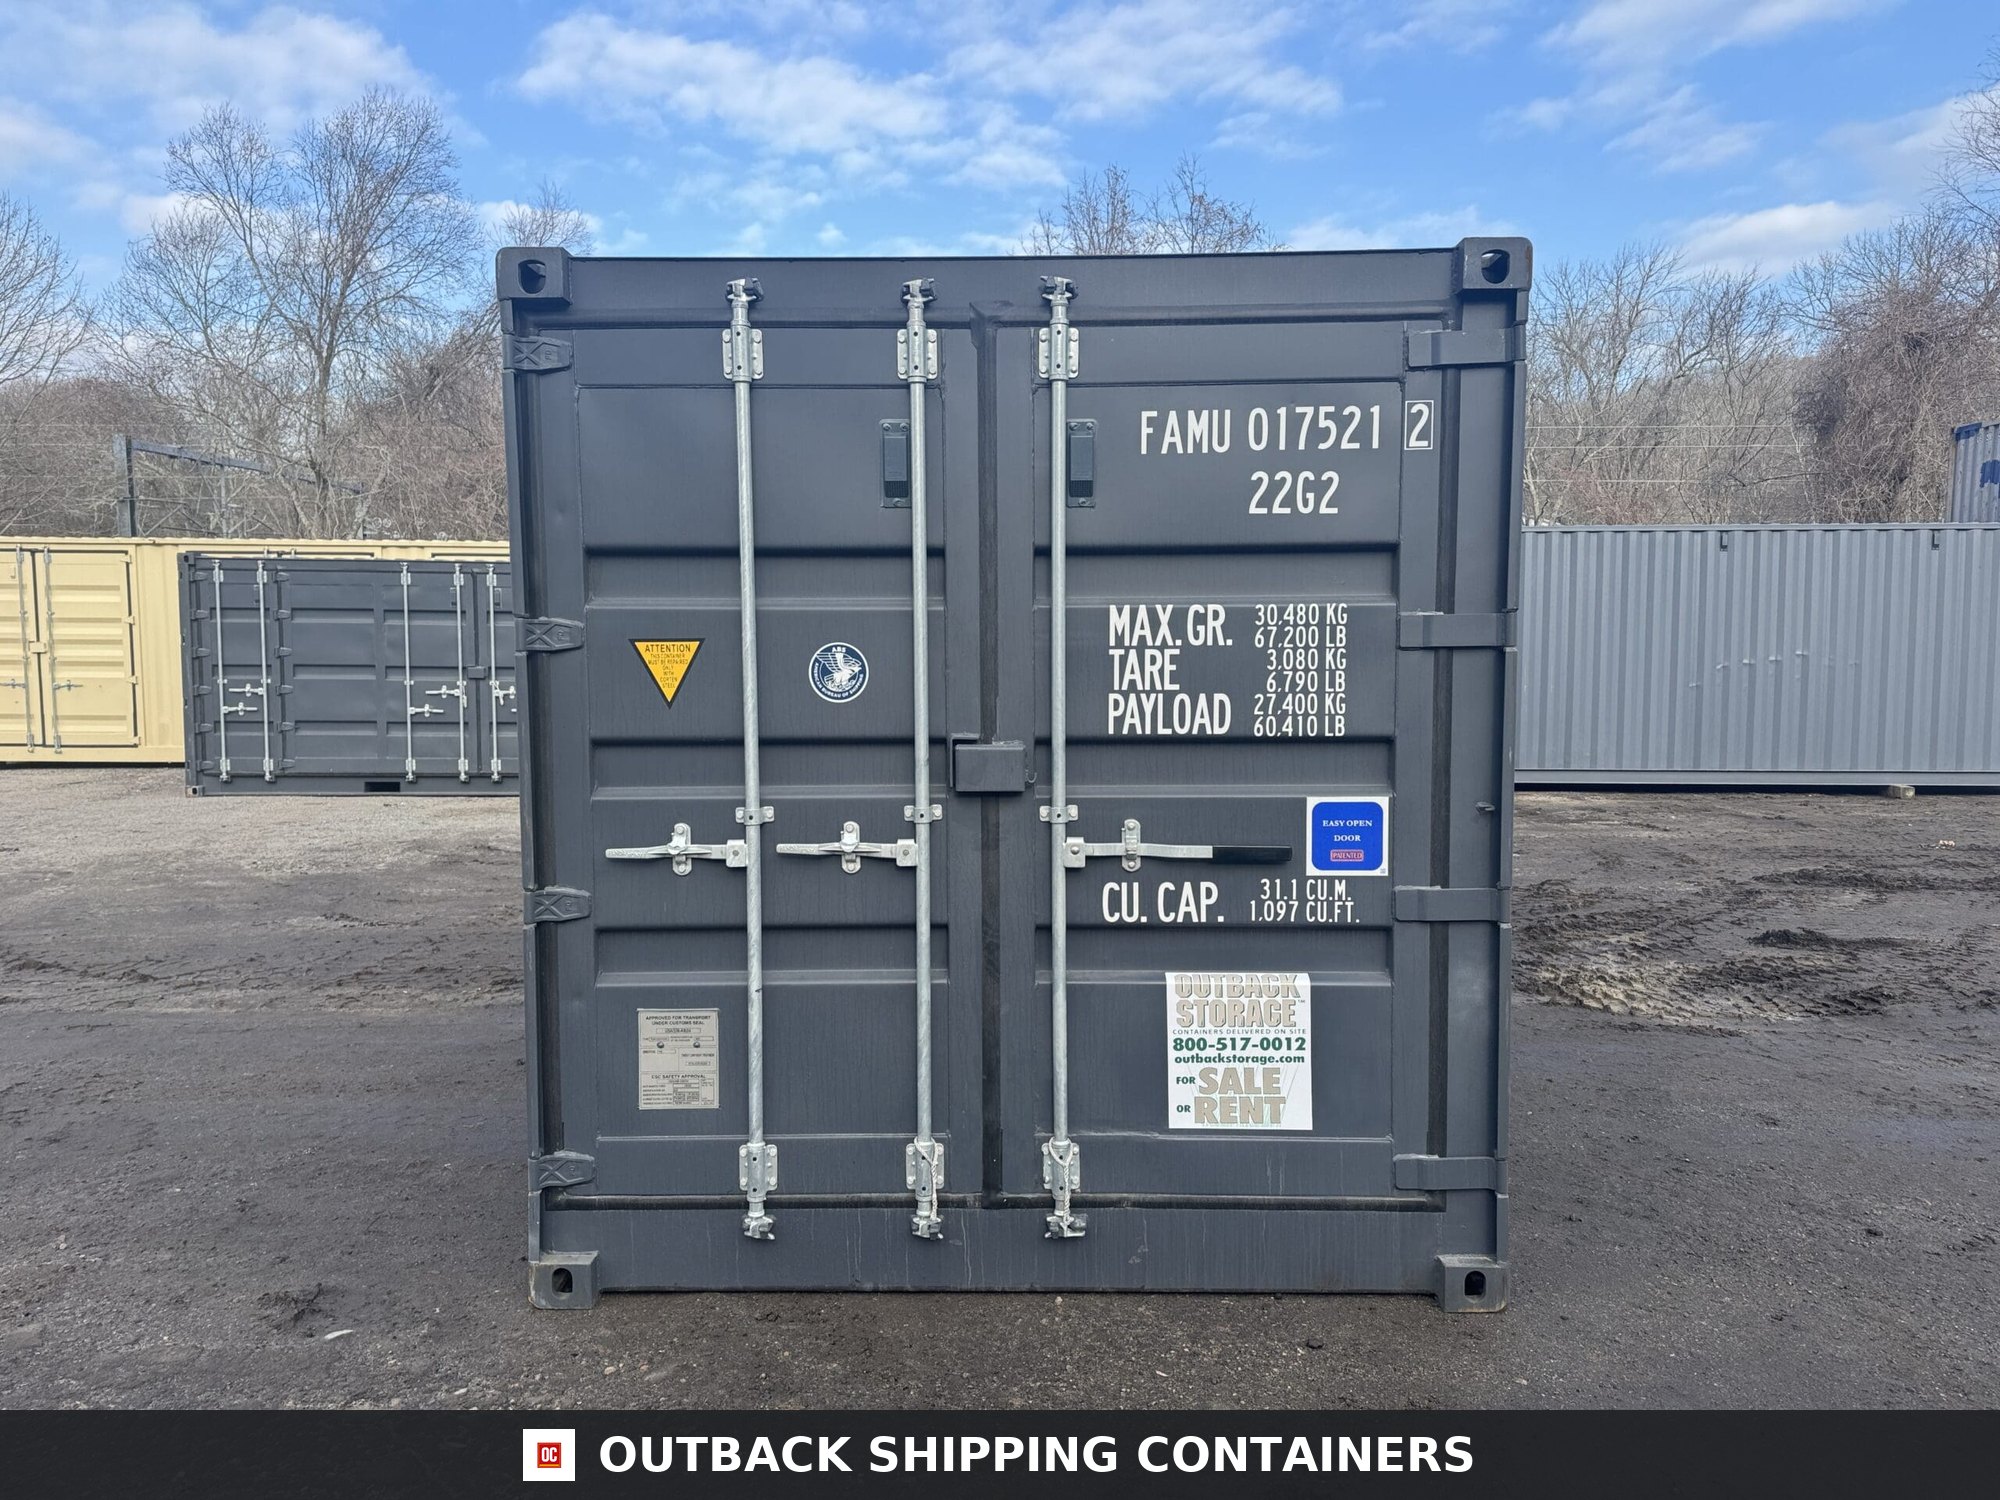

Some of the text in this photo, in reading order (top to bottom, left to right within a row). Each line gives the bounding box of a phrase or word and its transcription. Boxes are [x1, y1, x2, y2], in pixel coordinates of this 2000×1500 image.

[1140, 403, 1430, 455] FAMU 017521 2
[1248, 470, 1340, 515] 22G2
[1109, 603, 1348, 646] MAX. GR. 30,480 KG
[1255, 626, 1346, 648] 67,200 LB
[645, 644, 690, 652] ATTENTION
[1109, 648, 1346, 690] TARE 3,080 KG
[1266, 671, 1346, 692] 6,790 LB
[1108, 693, 1346, 735] PAYLOAD 27,400 KG
[1253, 715, 1345, 737] 60,410 LB
[1102, 881, 1147, 923] CU.
[1158, 881, 1224, 923] CAP.
[1260, 879, 1297, 899] 31.1
[1250, 900, 1298, 922] 1,097
[1174, 974, 1300, 998] OUTBACK
[1176, 999, 1297, 1028] STORAGE
[1173, 1037, 1306, 1051] 800-517-0012
[1175, 1053, 1305, 1065] outbackstorage.com
[1198, 1067, 1281, 1095] SALE
[1194, 1096, 1286, 1124] RENT
